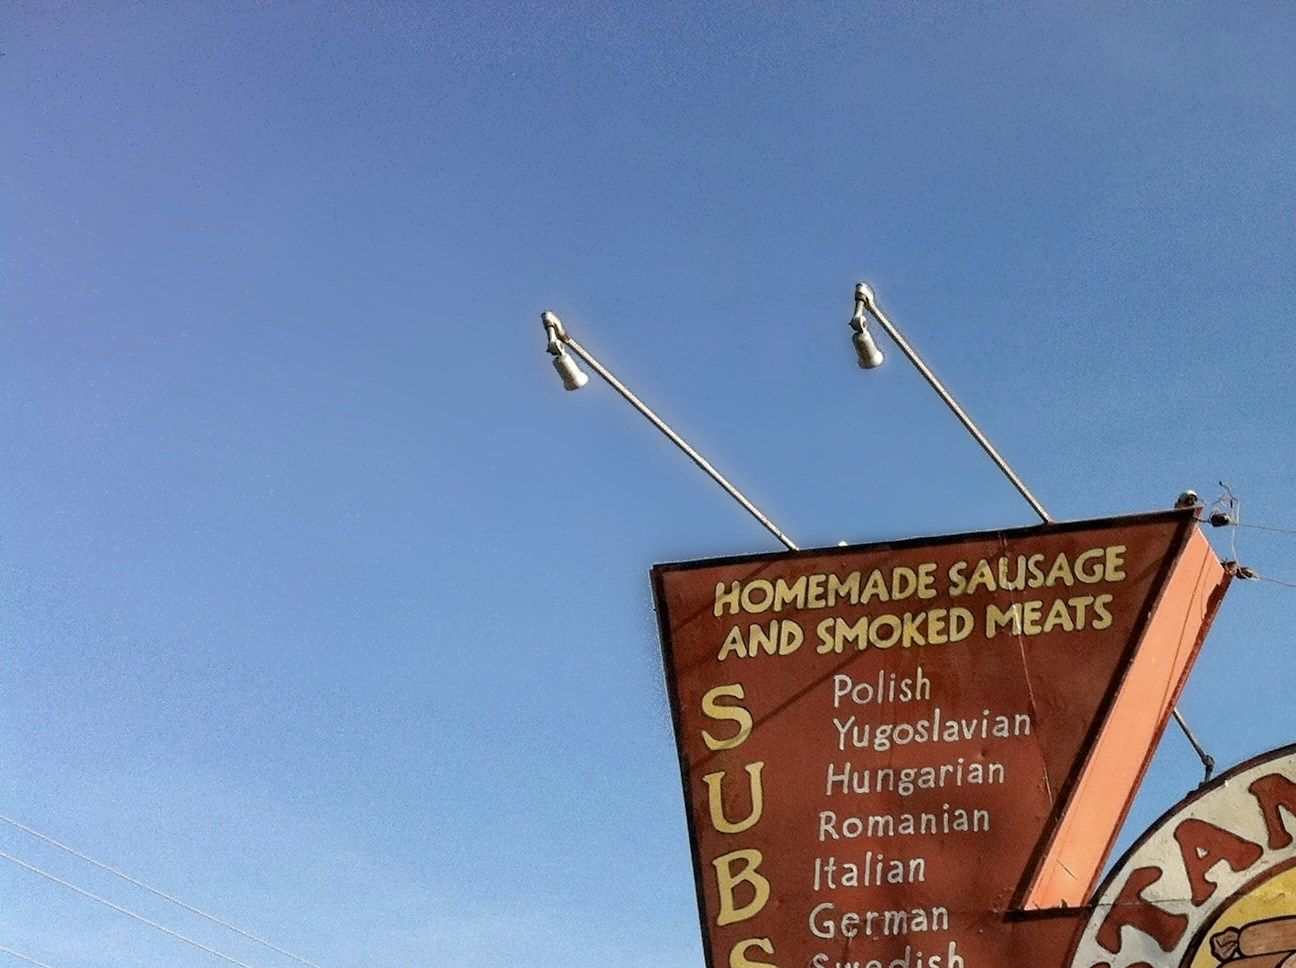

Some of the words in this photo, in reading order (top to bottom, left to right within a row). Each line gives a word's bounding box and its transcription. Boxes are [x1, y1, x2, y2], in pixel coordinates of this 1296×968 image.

[713, 562, 936, 617] HOMEMADE
[947, 545, 1127, 595] SAUSAGE
[717, 621, 804, 661] AND
[816, 607, 974, 655] SMOKED
[985, 594, 1114, 638] MEATS
[833, 667, 932, 707] Polish
[833, 708, 1032, 752] Yugoslavian
[825, 760, 1005, 796] Hungarian
[818, 805, 991, 841] Romanian
[812, 851, 926, 891] Italian
[808, 902, 950, 940] German
